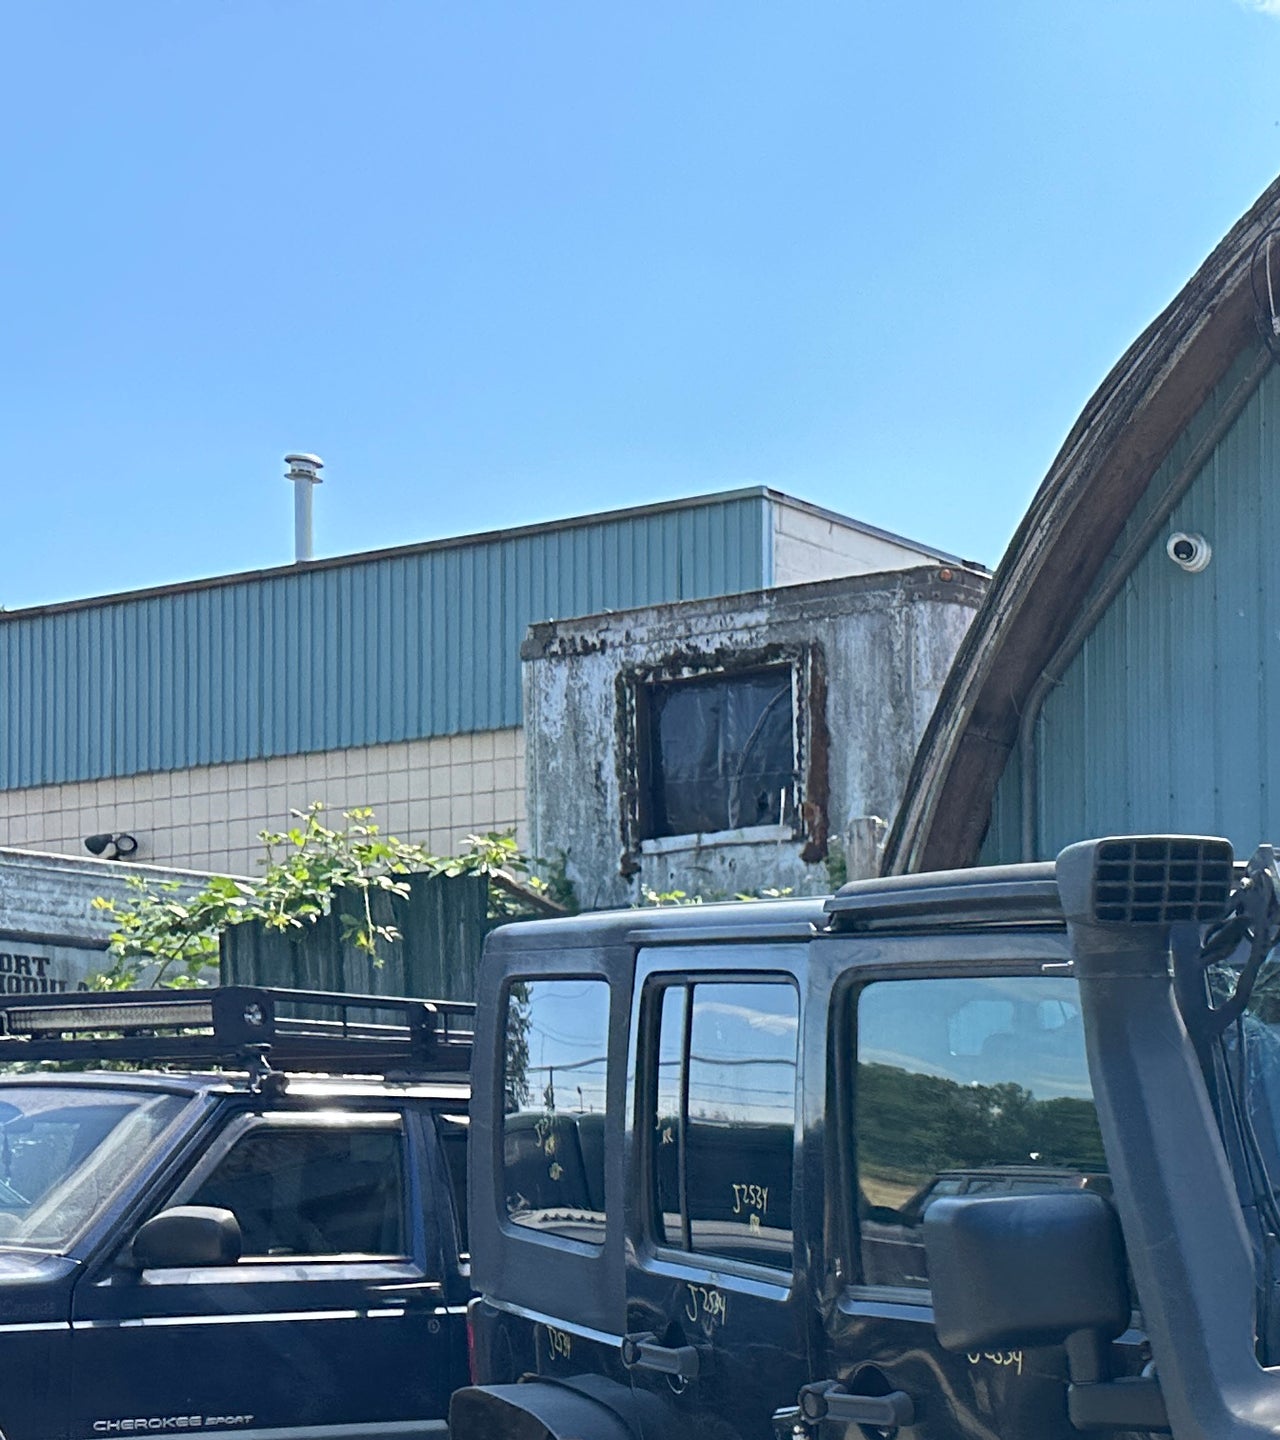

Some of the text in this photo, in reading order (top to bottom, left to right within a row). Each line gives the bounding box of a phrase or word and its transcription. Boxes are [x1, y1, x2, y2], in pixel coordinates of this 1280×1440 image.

[732, 1184, 769, 1214] J2534
[93, 1415, 254, 1431] CHEROKEE SPORT
